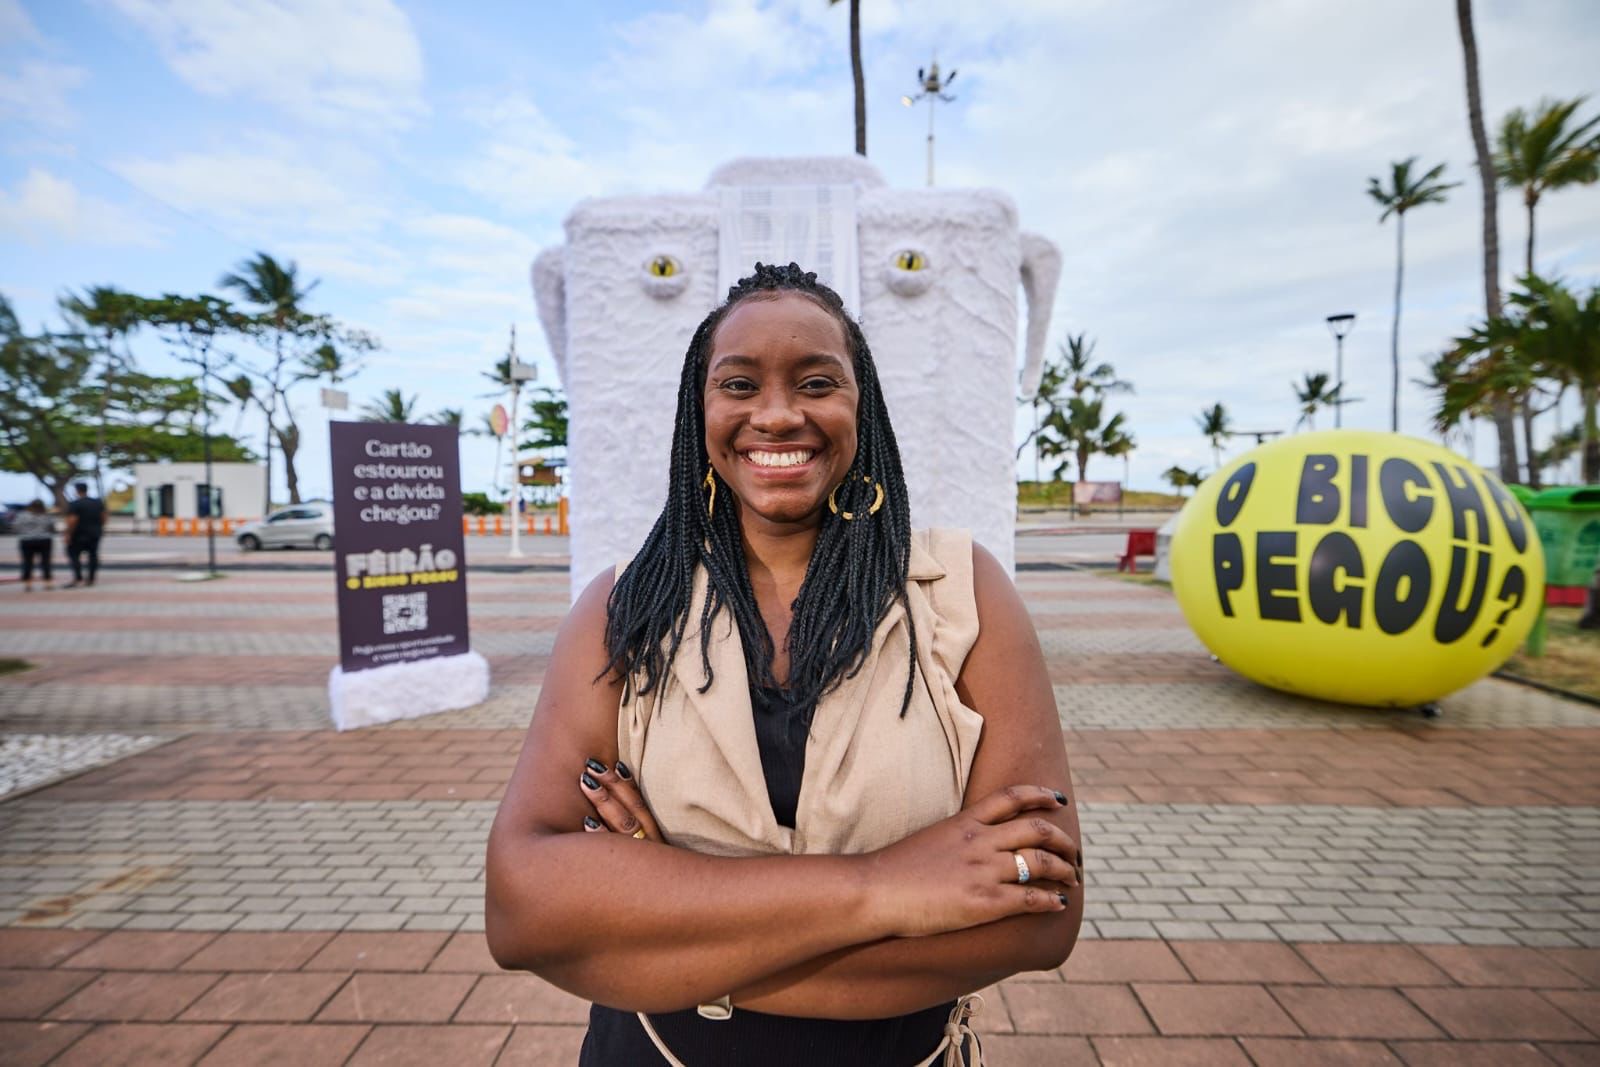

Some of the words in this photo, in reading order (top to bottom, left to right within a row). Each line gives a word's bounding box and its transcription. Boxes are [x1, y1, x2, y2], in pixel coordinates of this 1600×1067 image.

[364, 439, 433, 459] Cartão
[353, 463, 444, 480] estourou
[353, 485, 369, 501] e
[370, 485, 384, 501] a
[385, 482, 446, 500] dívida
[360, 503, 442, 525] chegou?
[1216, 461, 1257, 527] O
[1295, 453, 1528, 555] BICHO
[345, 543, 458, 577] FEIRÃO
[1212, 530, 1527, 648] PEGOU?
